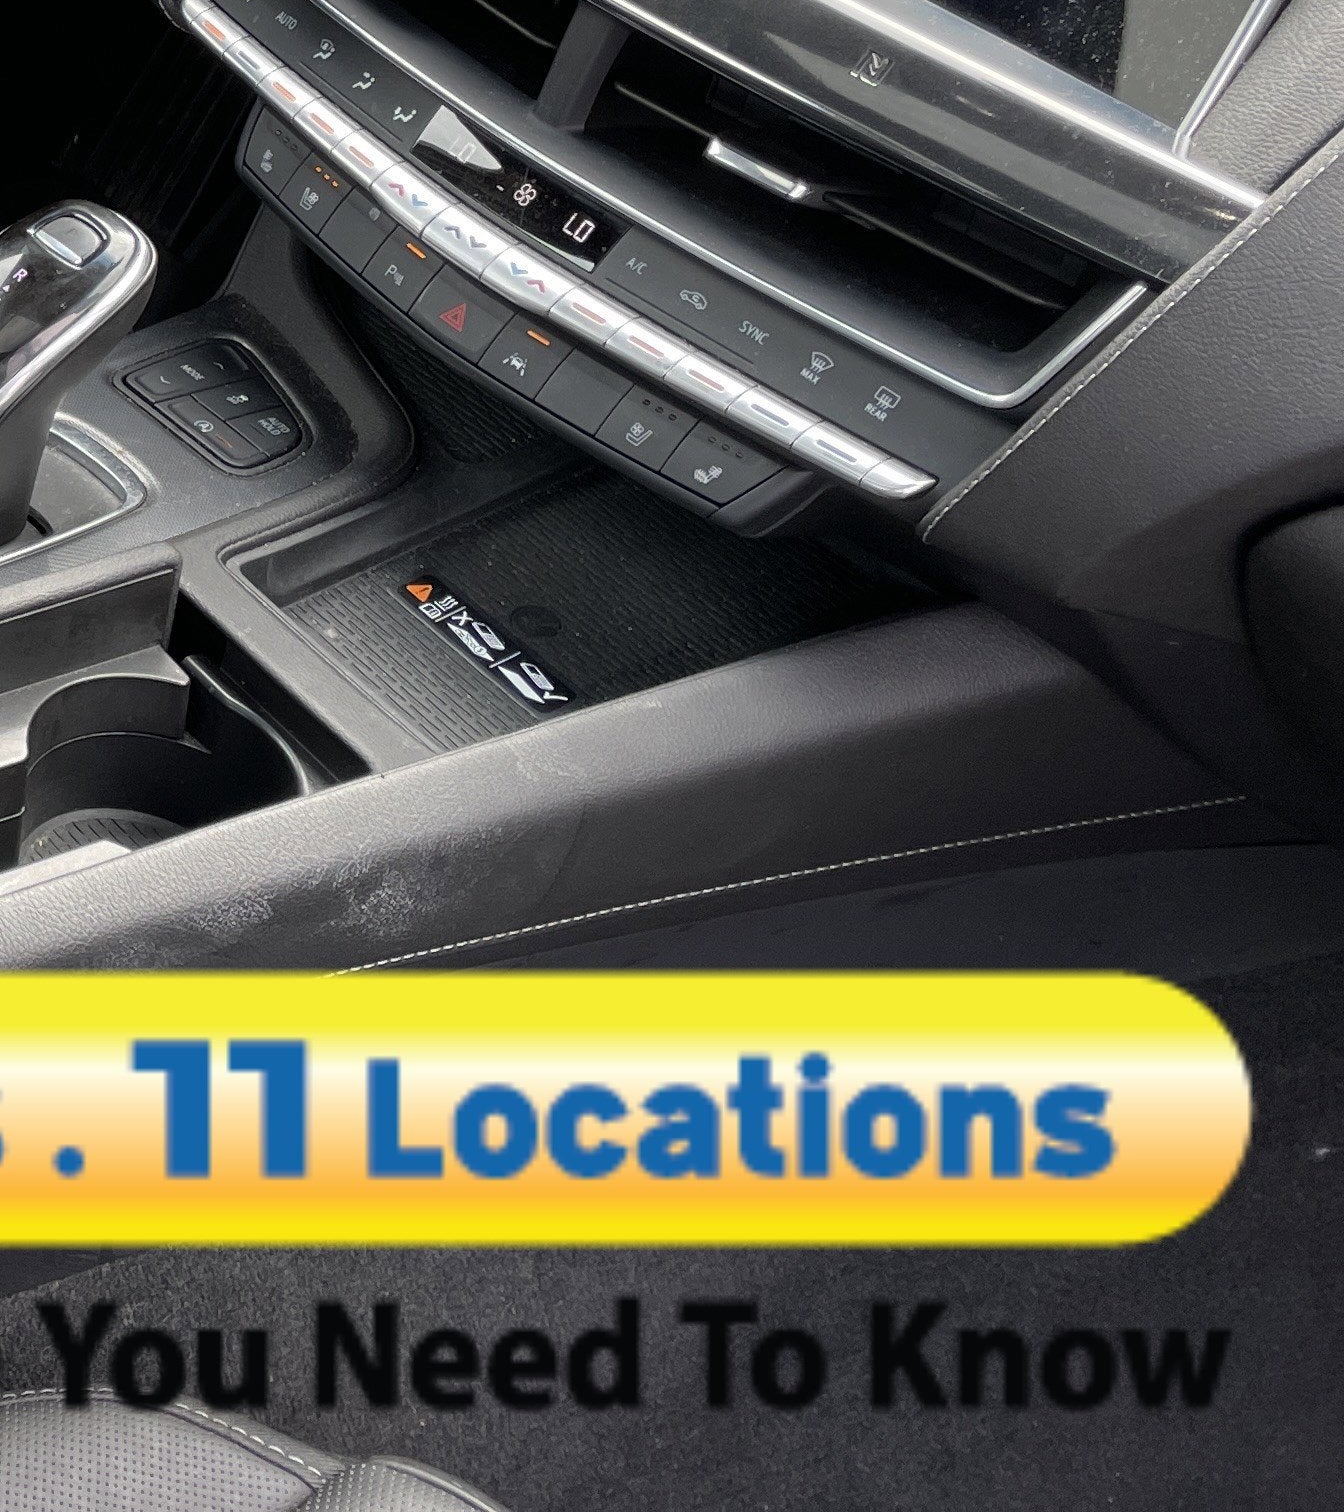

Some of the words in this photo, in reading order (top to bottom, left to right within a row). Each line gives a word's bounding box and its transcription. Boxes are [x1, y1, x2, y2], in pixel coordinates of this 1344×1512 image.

[274, 10, 298, 30] AUTO
[562, 212, 596, 244] LO
[12, 268, 28, 282] R
[625, 257, 648, 276] A/C
[738, 320, 770, 346] SYNC
[180, 364, 205, 381] MODE
[799, 367, 822, 386] MAX
[863, 403, 889, 422] REAR
[258, 418, 282, 436] HOLD
[267, 416, 291, 434] AUTO
